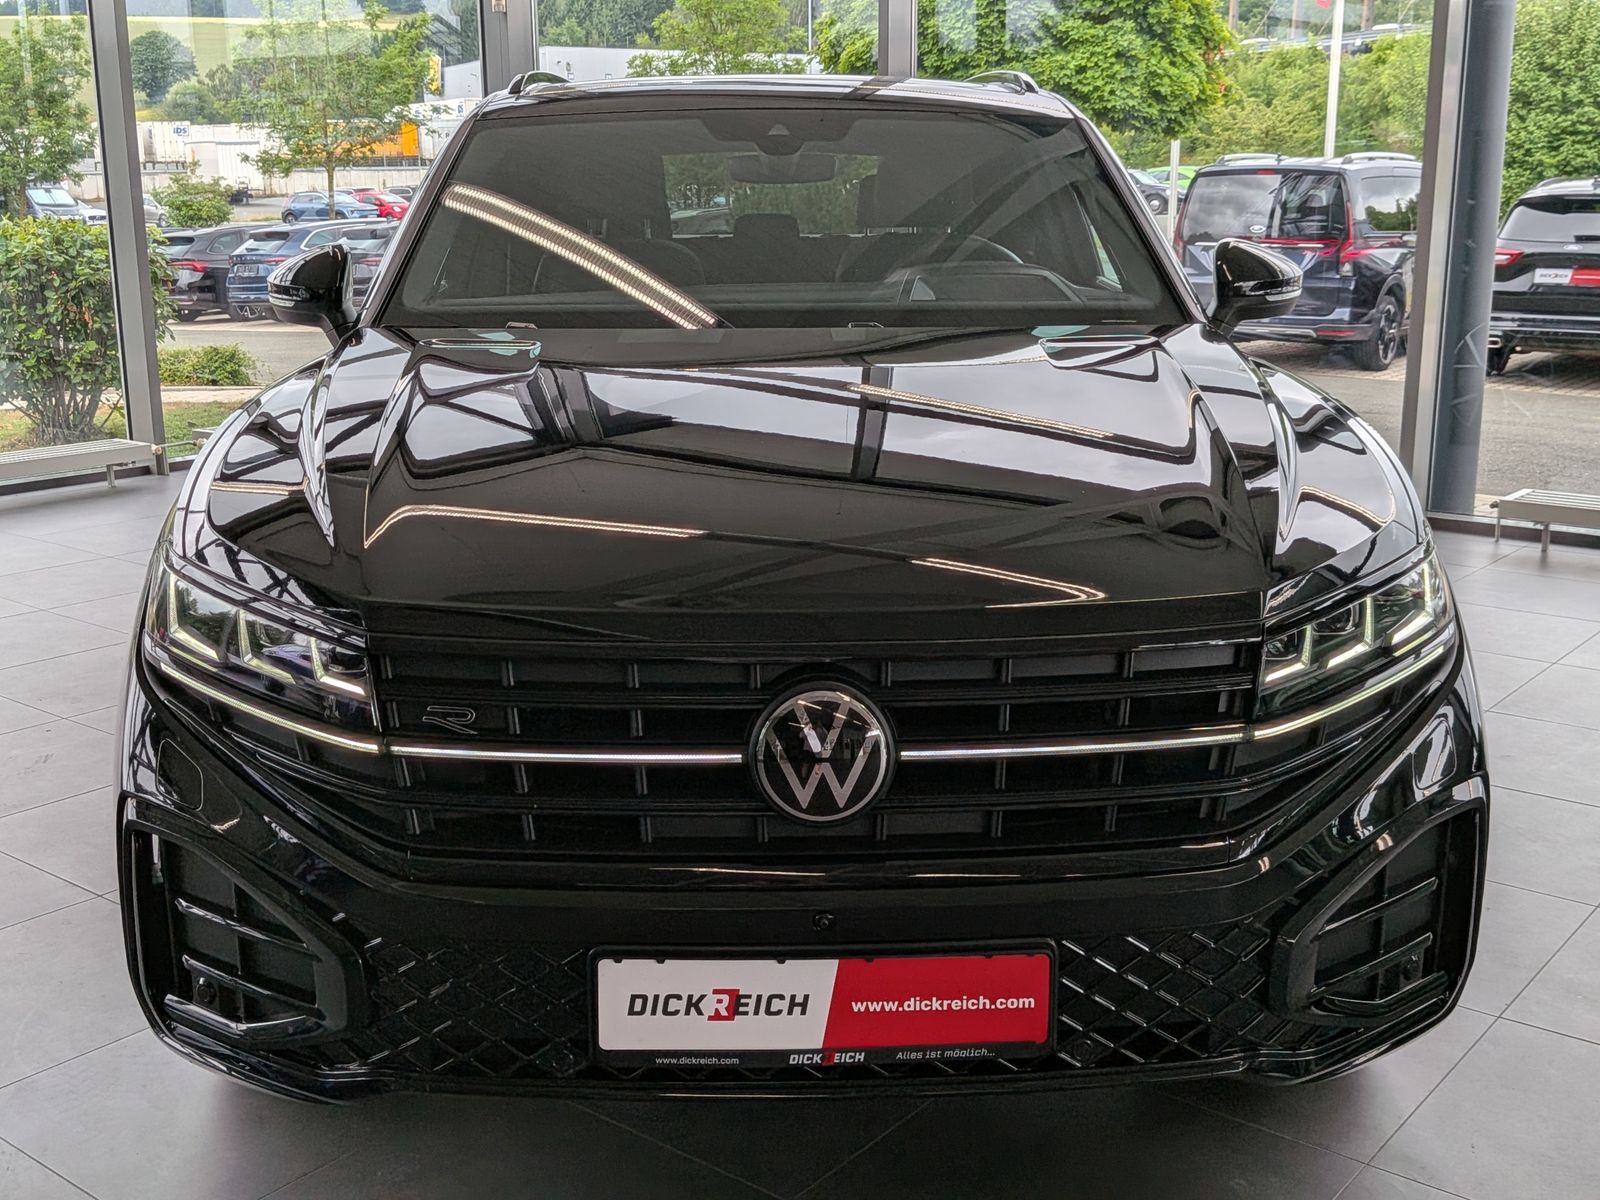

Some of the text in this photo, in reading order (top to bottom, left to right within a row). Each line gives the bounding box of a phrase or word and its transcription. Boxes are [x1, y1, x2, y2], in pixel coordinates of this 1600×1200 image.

[627, 992, 1035, 1018] DICKREICH www.dickreich.com
[655, 1056, 739, 1065] www.dickreich.com
[896, 1051, 923, 1060] Alles
[925, 1050, 942, 1058] ist
